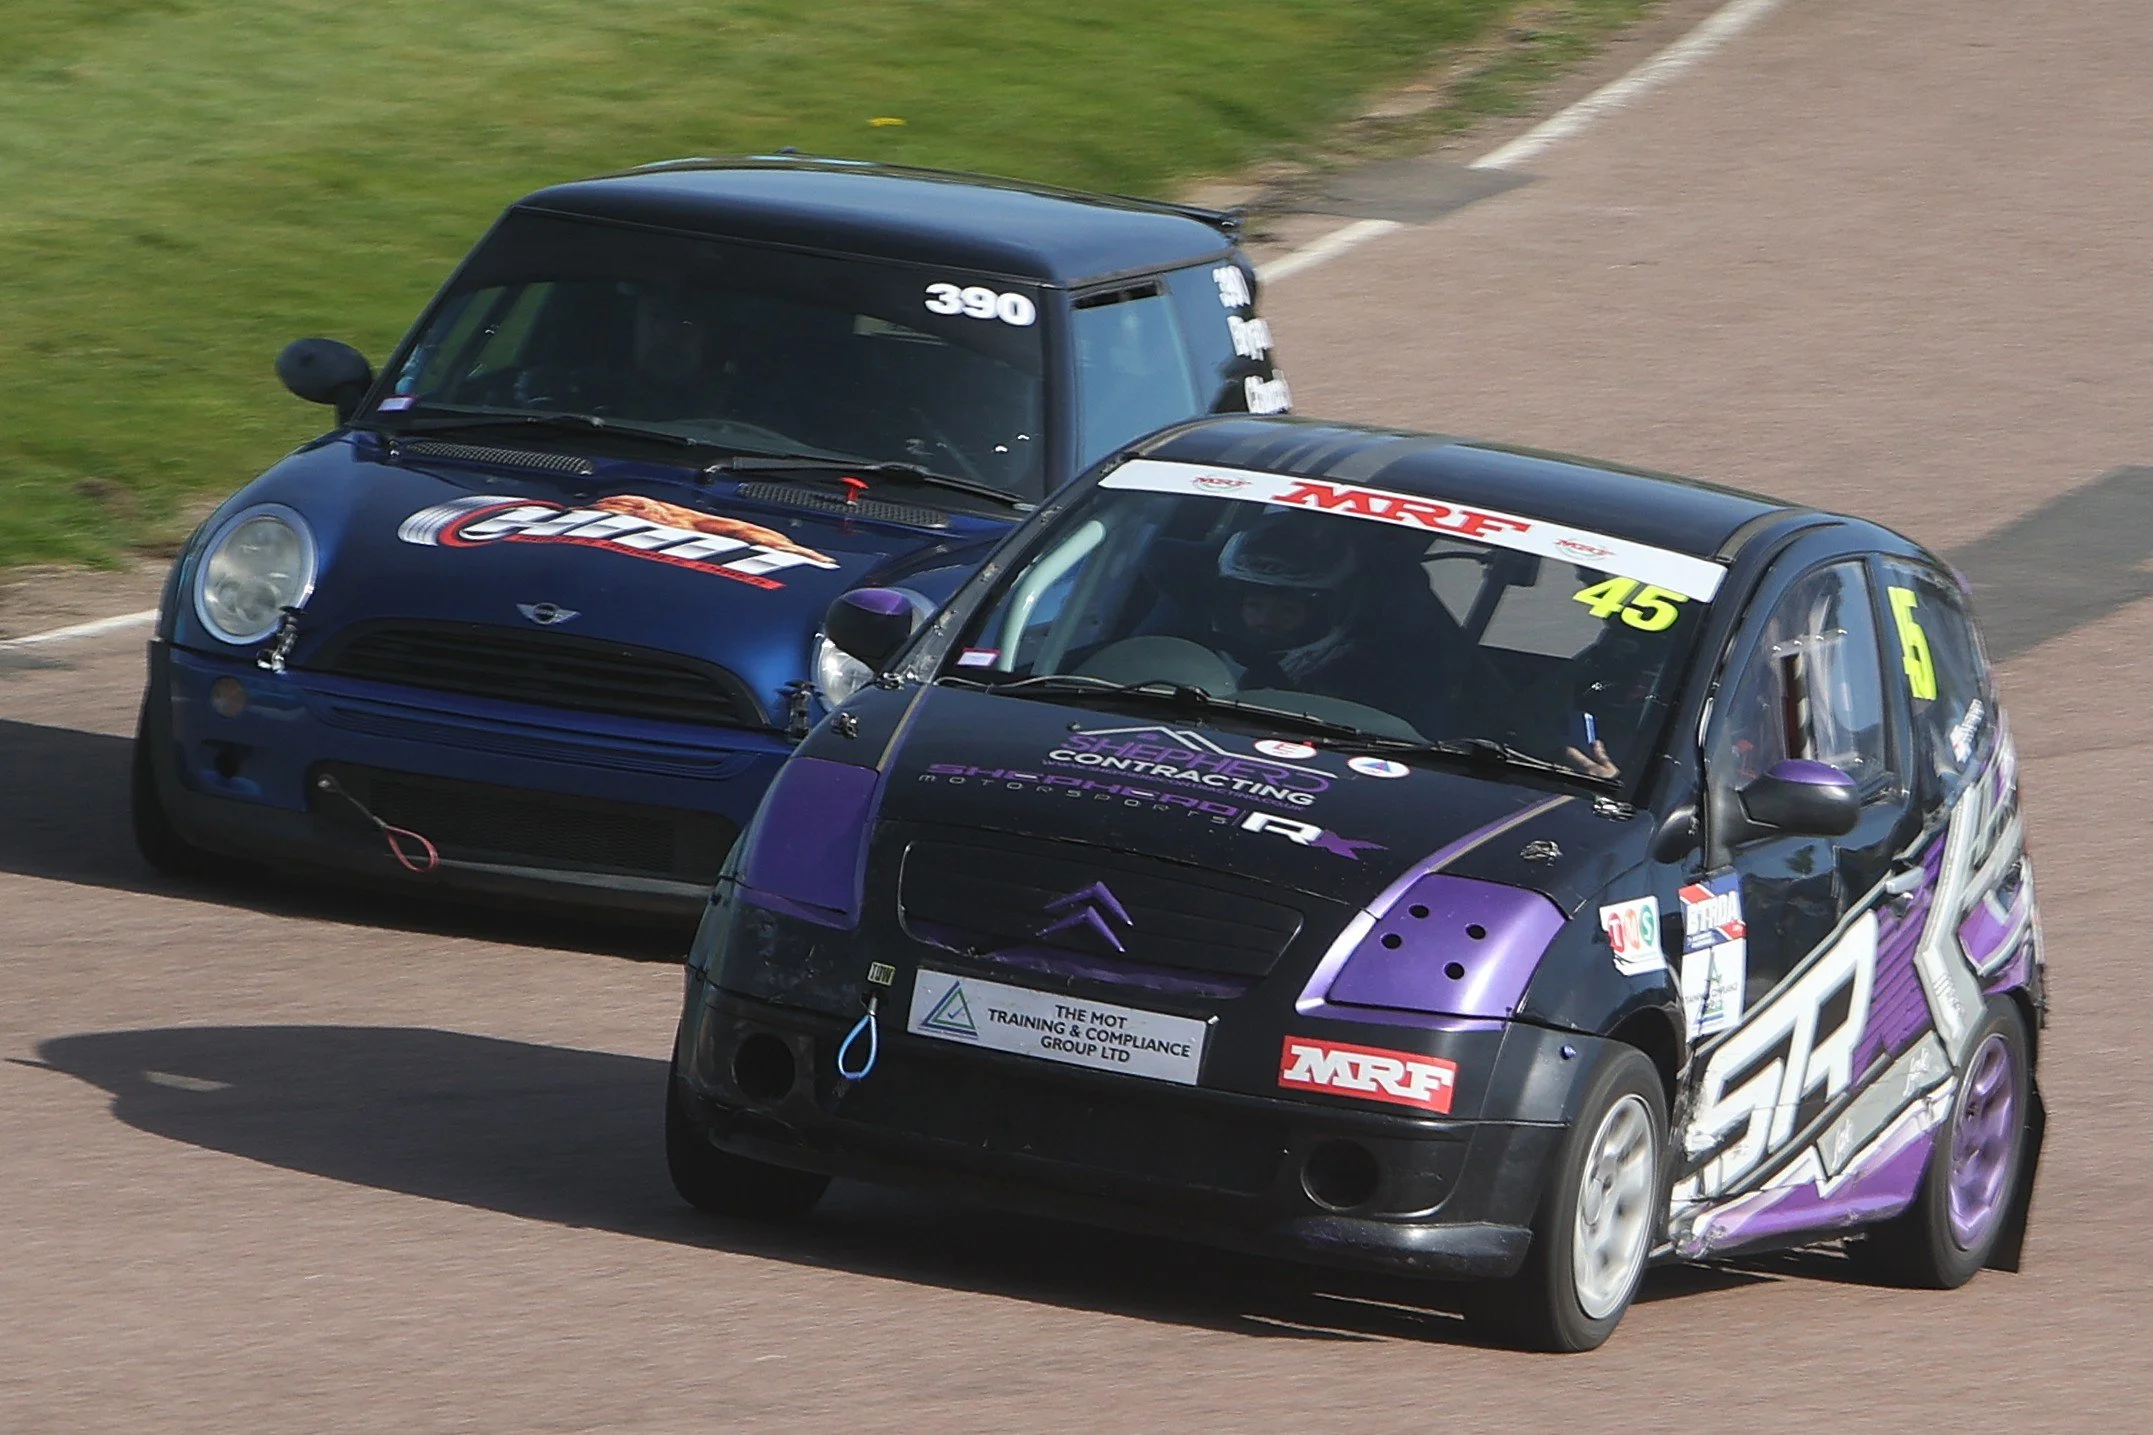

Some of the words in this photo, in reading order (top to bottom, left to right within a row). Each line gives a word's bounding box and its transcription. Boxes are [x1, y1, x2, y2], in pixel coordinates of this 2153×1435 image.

[924, 282, 1037, 326] 390
[1272, 481, 1534, 538] MRF
[1573, 576, 1691, 633] 45
[924, 762, 1241, 818] SHEPHERD
[1048, 747, 1318, 807] CONTRACTING
[987, 1008, 1066, 1036] TRAINING
[1069, 1026, 1082, 1038] &
[1085, 1029, 1191, 1058] COMPLIANCE
[1055, 1004, 1088, 1023] THE
[1091, 1013, 1128, 1030] MOT
[1040, 1036, 1098, 1057] GROUP
[1101, 1045, 1131, 1063] LTD
[1282, 1044, 1456, 1102] MRF
